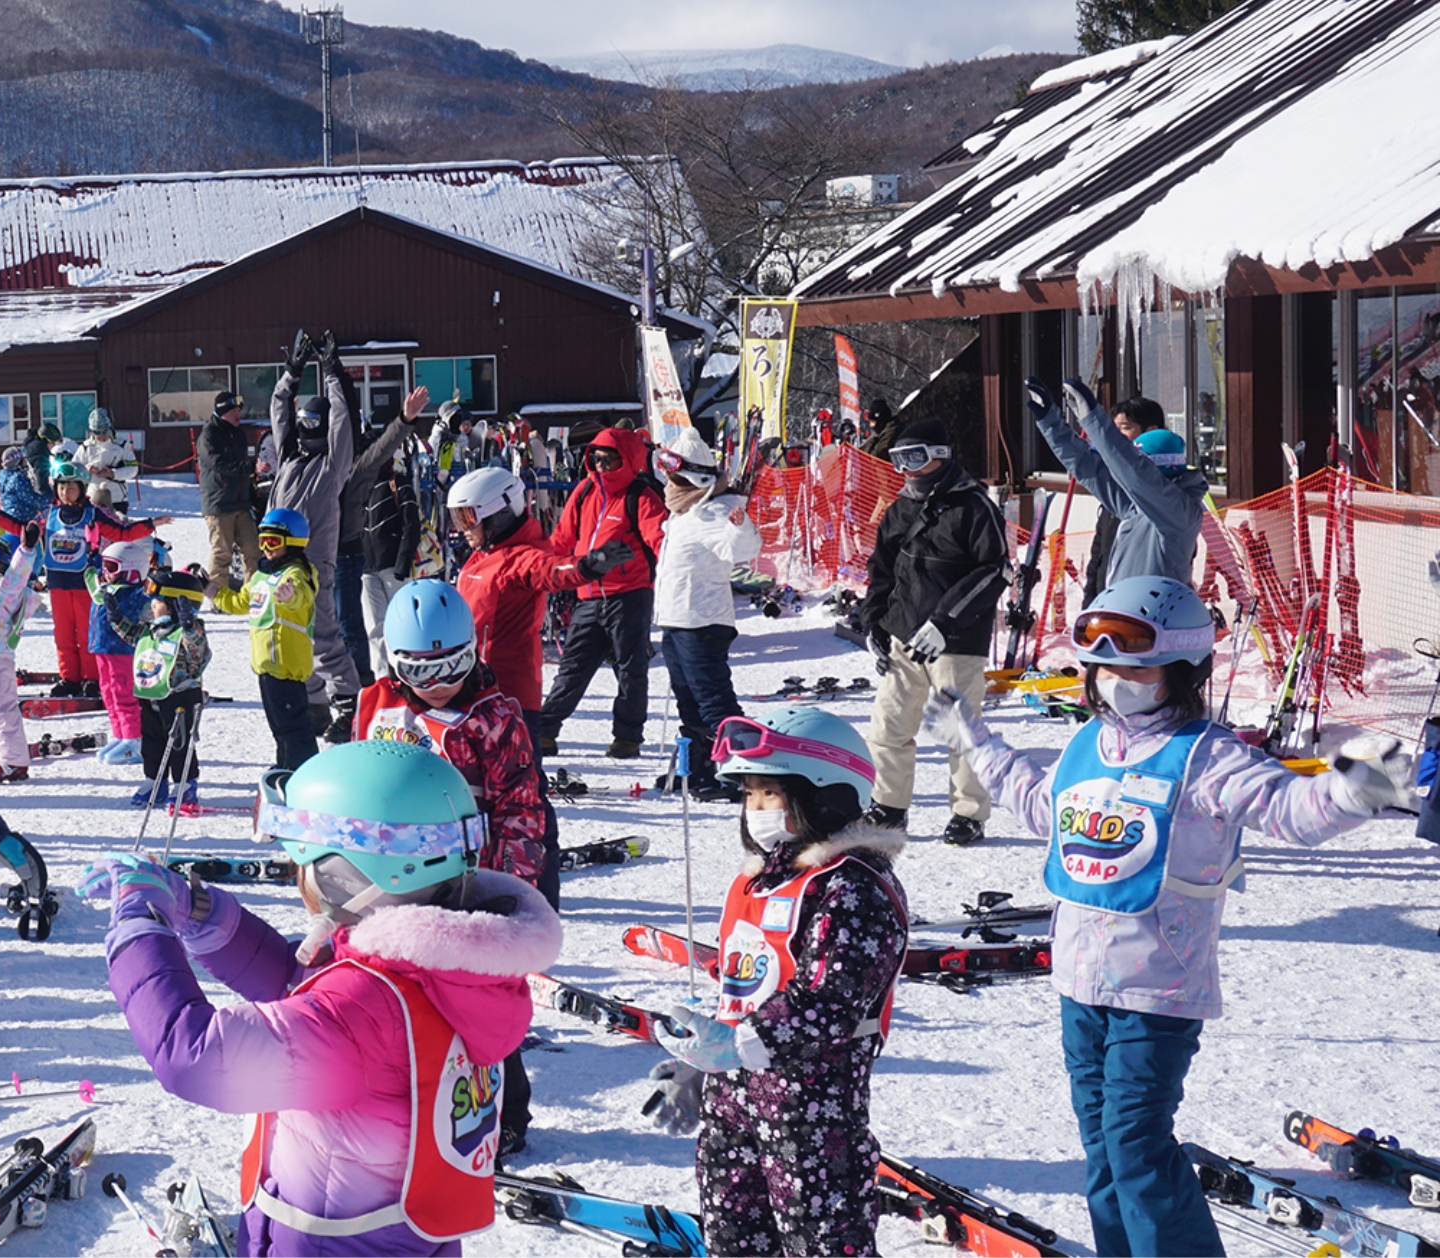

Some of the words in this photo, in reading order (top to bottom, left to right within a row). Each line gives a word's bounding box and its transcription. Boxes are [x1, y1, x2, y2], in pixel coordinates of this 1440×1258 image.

[1059, 806, 1146, 845] SKIDS
[1065, 856, 1119, 881] CAMP
[725, 951, 769, 980] IDS
